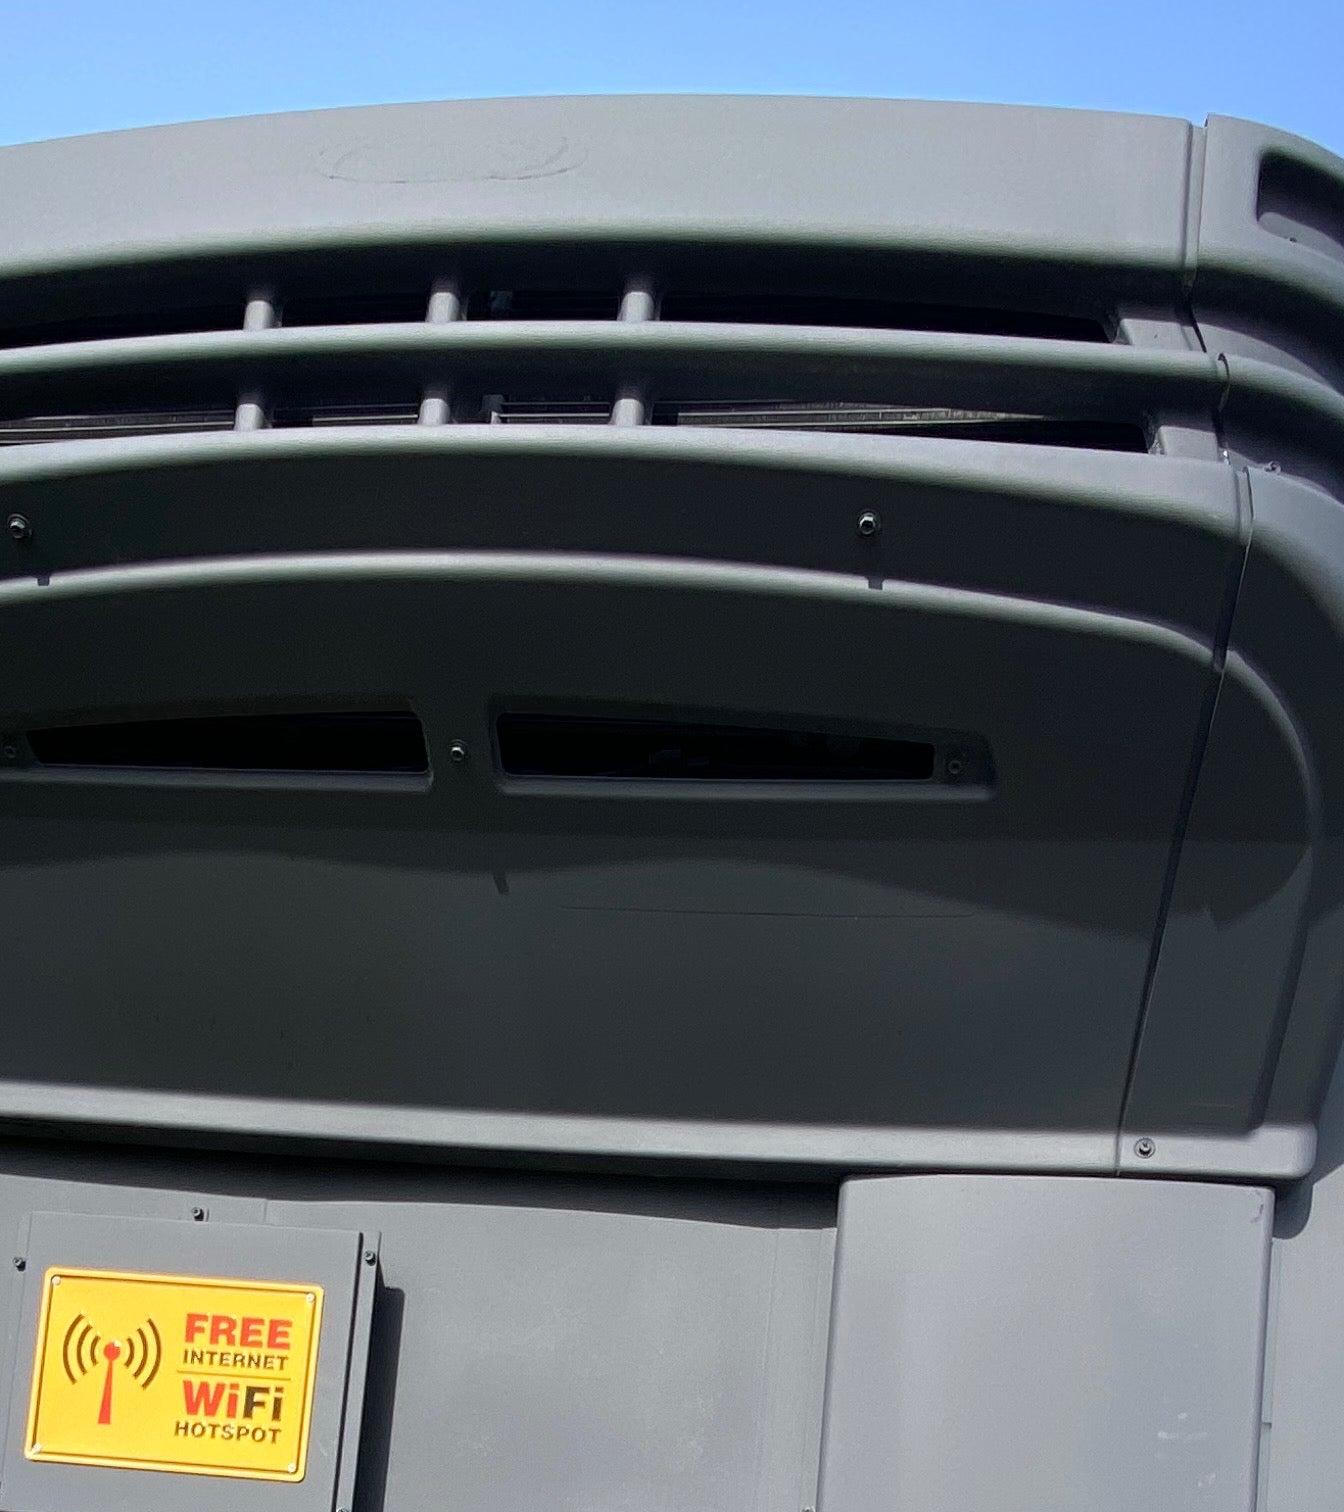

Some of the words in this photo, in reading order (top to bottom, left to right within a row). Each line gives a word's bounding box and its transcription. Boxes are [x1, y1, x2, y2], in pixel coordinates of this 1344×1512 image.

[185, 1313, 292, 1349] FREE
[183, 1350, 288, 1370] INTERNET
[183, 1380, 284, 1421] WiFi
[175, 1420, 282, 1444] HOTSPOT
